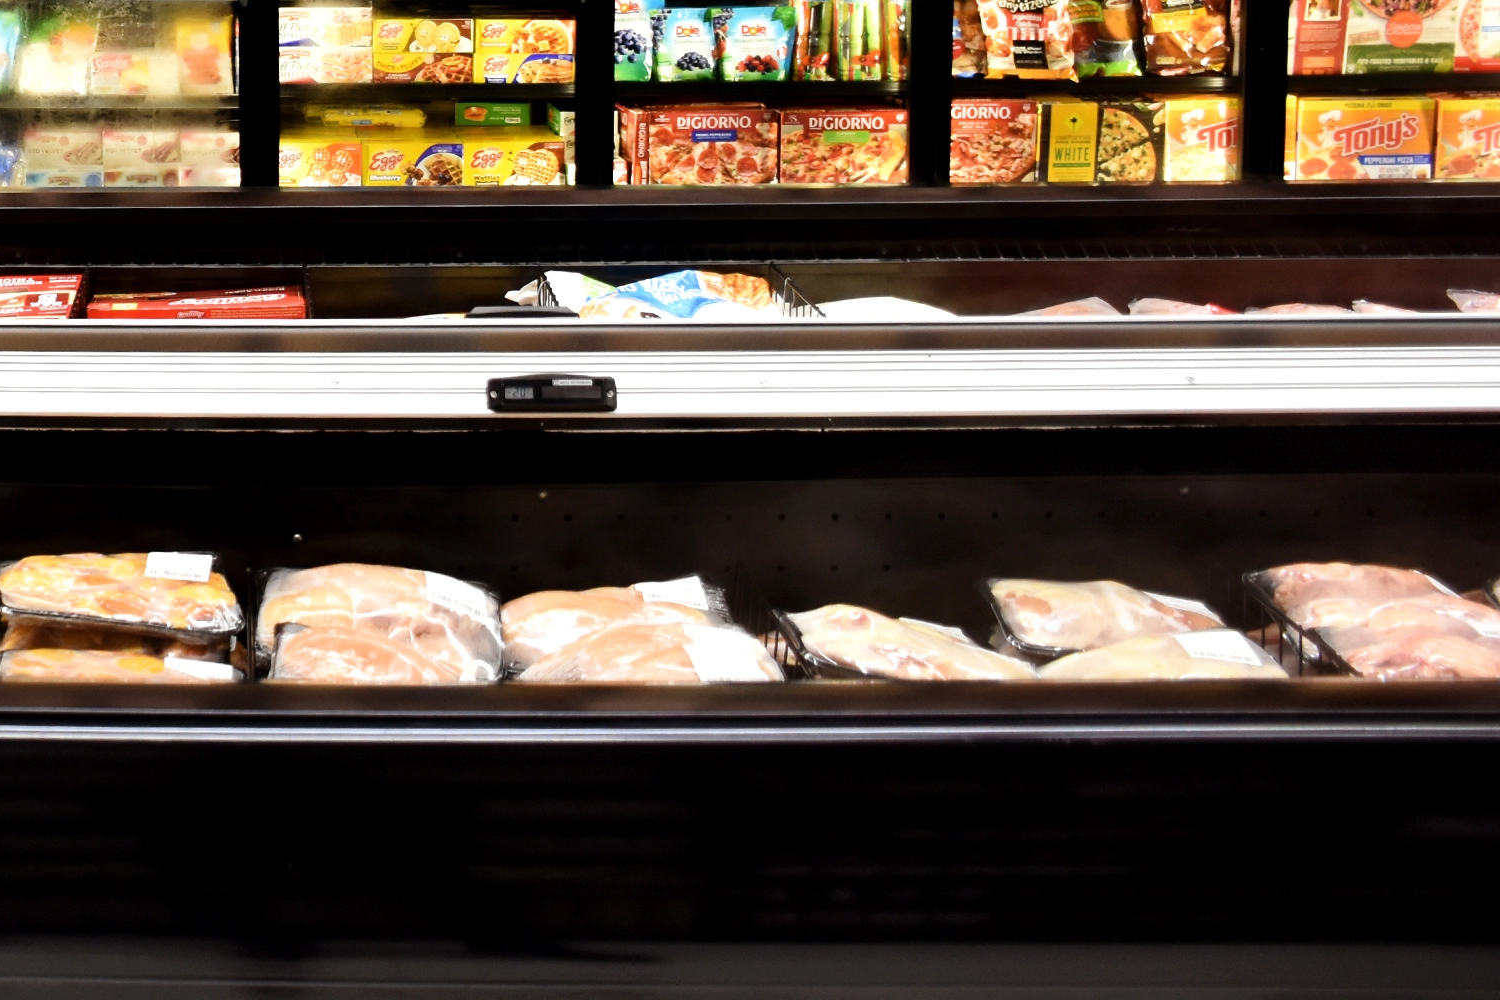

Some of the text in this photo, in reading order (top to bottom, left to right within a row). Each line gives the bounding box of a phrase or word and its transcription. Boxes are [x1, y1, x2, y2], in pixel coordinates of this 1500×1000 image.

[378, 24, 403, 39] Eggo
[481, 24, 508, 38] Eggo
[675, 25, 700, 36] Dole
[741, 25, 766, 35] Dole
[376, 55, 423, 71] THICK FLUFFY
[483, 57, 509, 71] Eggo
[676, 115, 751, 130] DIGIORNO
[808, 116, 885, 130] DIGIORNO
[1333, 112, 1419, 157] Tony's
[369, 150, 404, 172] Eggo
[470, 149, 504, 169] Eggo
[1054, 147, 1090, 161] WHITE
[369, 174, 402, 182] Blueberry
